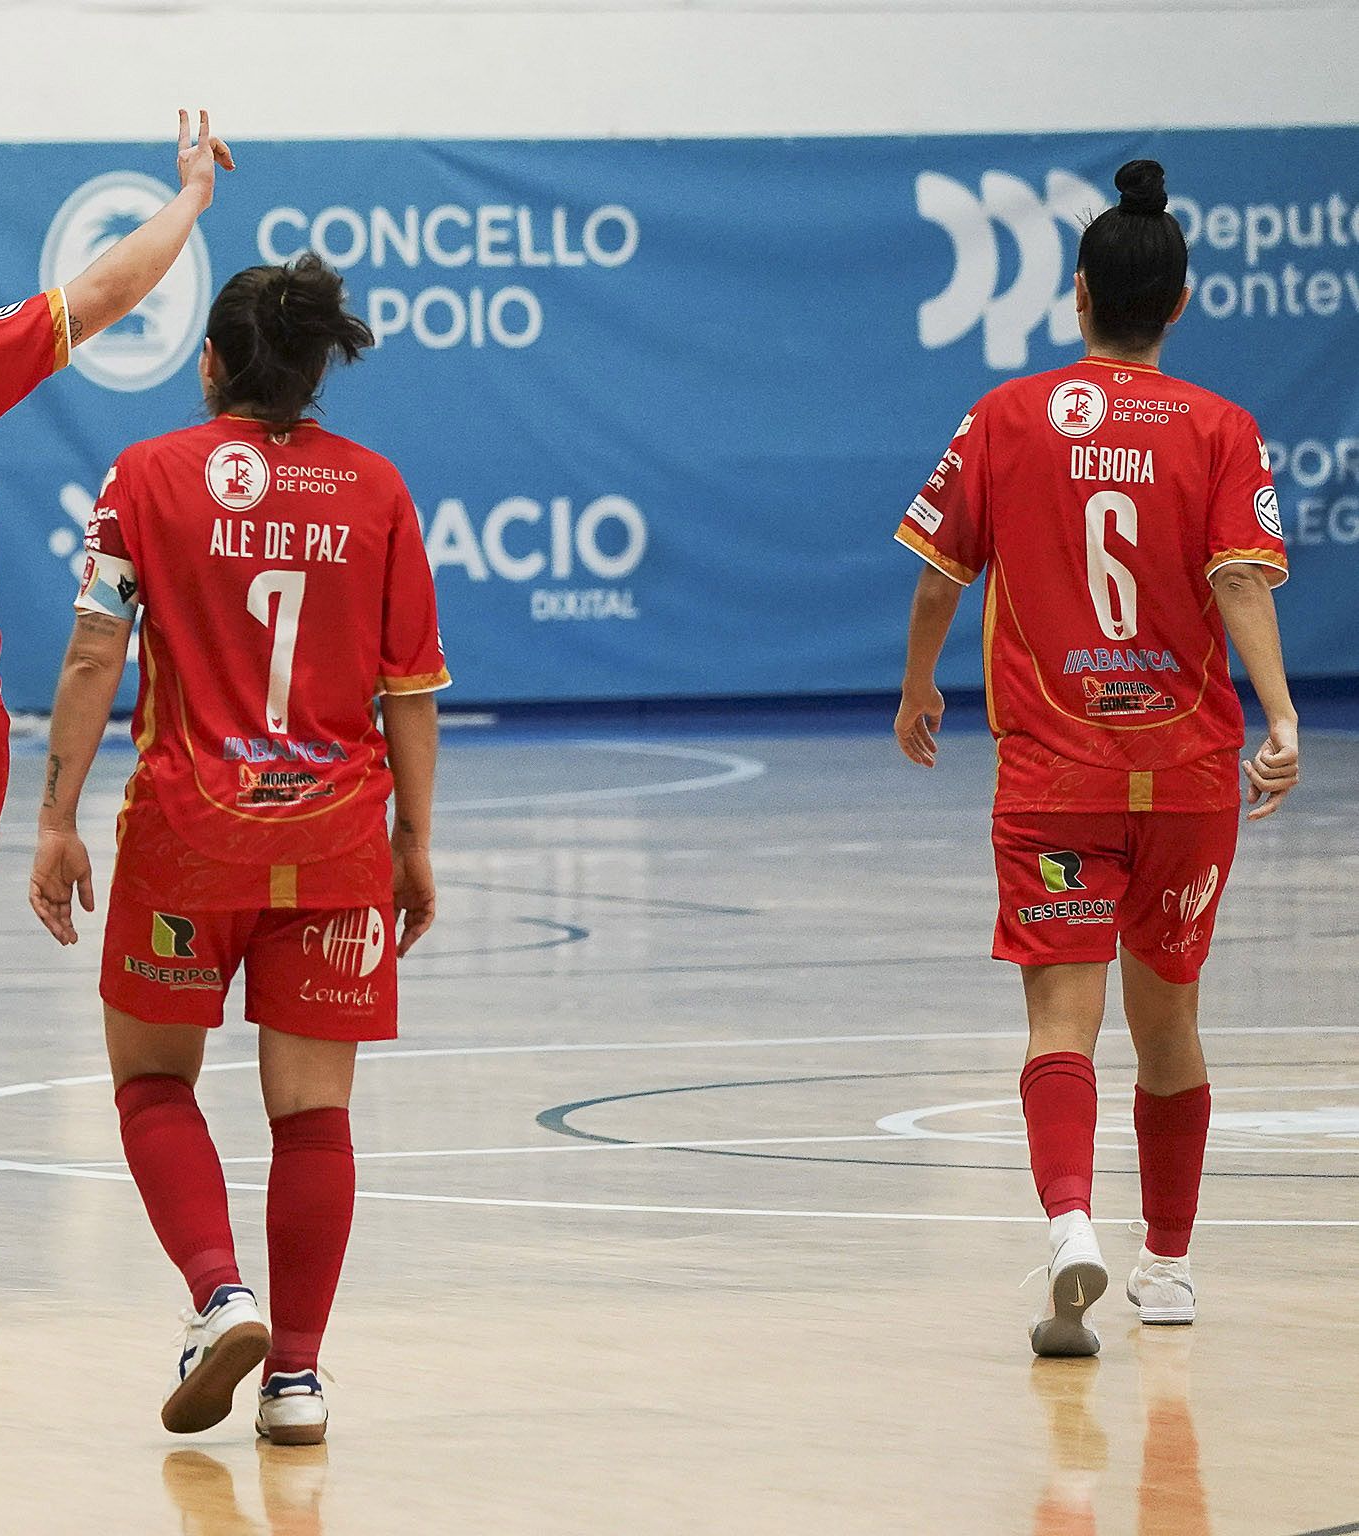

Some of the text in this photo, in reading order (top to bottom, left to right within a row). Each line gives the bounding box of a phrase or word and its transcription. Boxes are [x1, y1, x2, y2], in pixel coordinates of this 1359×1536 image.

[256, 204, 641, 269] CONCELLO
[1112, 410, 1169, 424] DE POIO
[1113, 398, 1190, 414] CONCELLO
[275, 464, 357, 482] CONCELLO
[1070, 440, 1155, 484] DÉBORA
[275, 479, 337, 495] DE POIO
[210, 518, 350, 563] ALE DE PAZ
[1084, 490, 1138, 641] 6
[246, 569, 307, 735] 7
